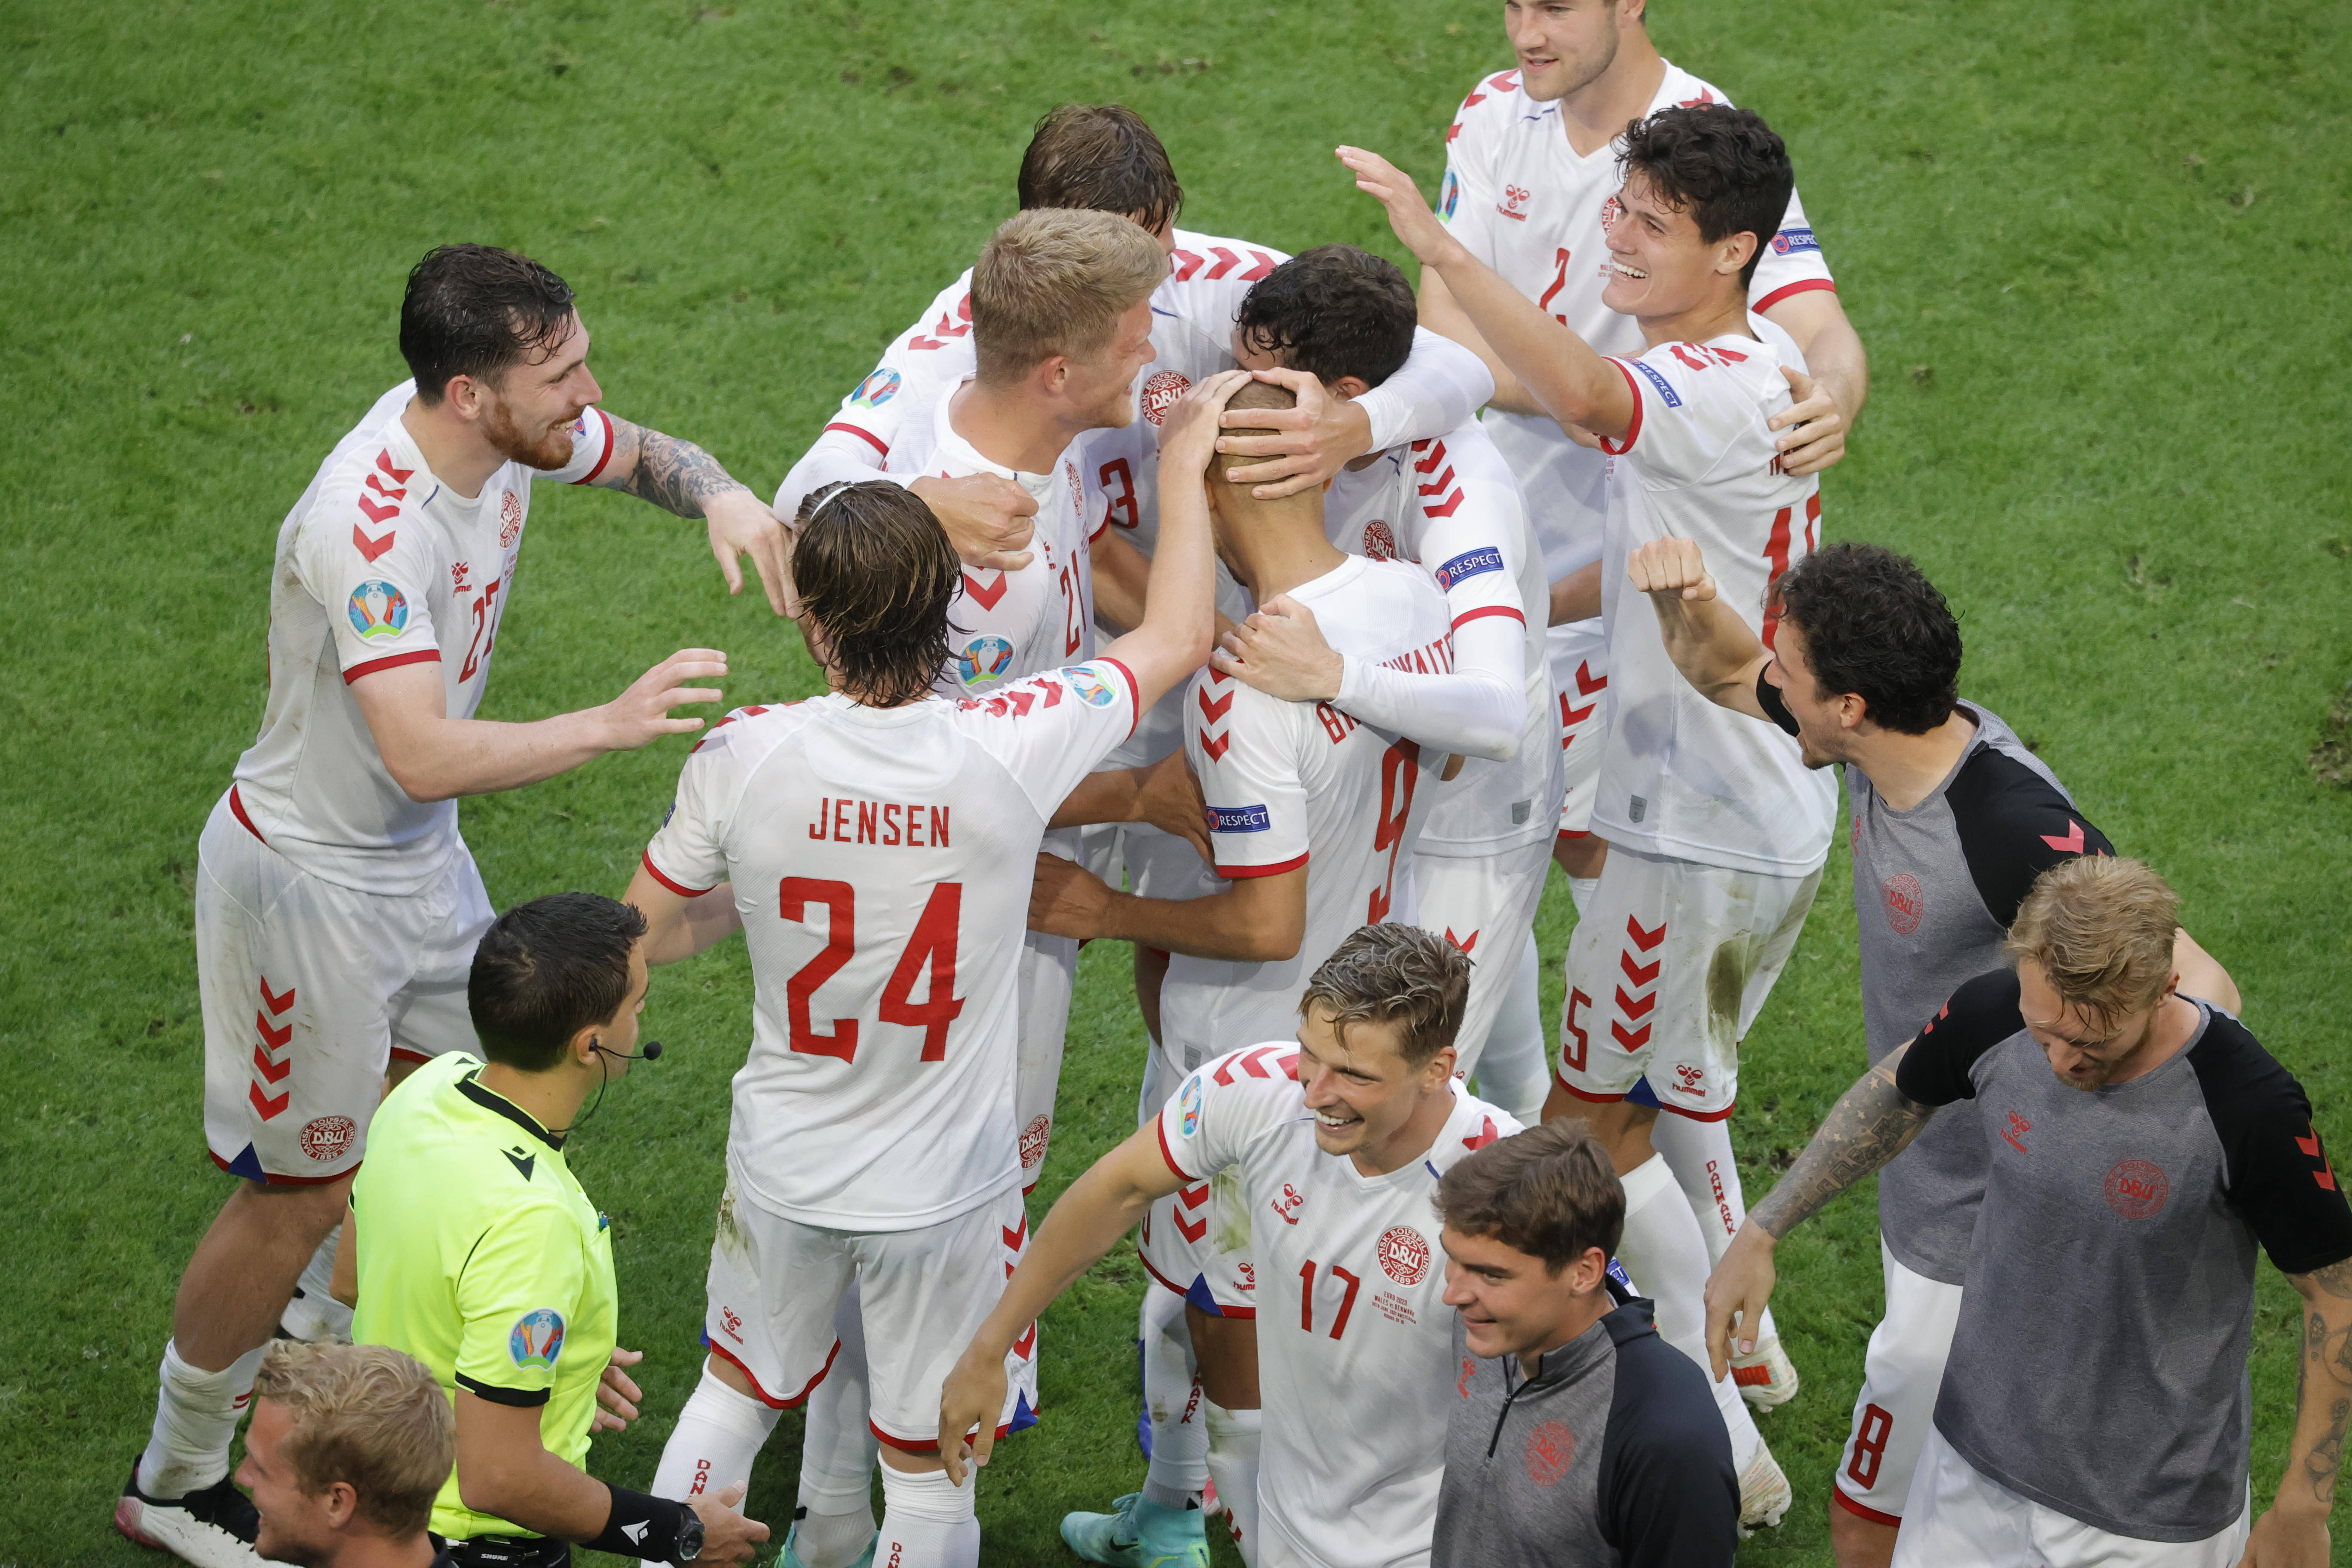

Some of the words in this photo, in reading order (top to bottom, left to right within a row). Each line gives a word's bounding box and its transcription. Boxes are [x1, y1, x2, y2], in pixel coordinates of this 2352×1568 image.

[1638, 364, 1678, 406] RESPECT
[1449, 553, 1500, 578] RESPECT
[1060, 549, 1086, 658] 21
[458, 576, 500, 683] 27
[809, 798, 949, 847] JENSEN
[1219, 812, 1266, 826] RESPECT
[1368, 737, 1420, 925] 9
[1889, 890, 1914, 916] DBU
[780, 877, 966, 1065] 24
[1564, 986, 1592, 1072] 5
[1672, 1083, 1706, 1097] hummel
[302, 1127, 314, 1155] DANSK
[340, 1126, 354, 1152] UNION
[311, 1130, 346, 1145] DBU
[1021, 1129, 1043, 1153] DBU
[1706, 1160, 1736, 1236] DANMARK
[2118, 1178, 2155, 1199] DBU
[1271, 1199, 1299, 1225] hummel
[1378, 1235, 1390, 1270] DANSK
[1388, 1242, 1421, 1269] DBU
[1389, 1271, 1411, 1285] 1889
[1413, 1254, 1429, 1283] UNION
[1299, 1259, 1360, 1340] 17
[1375, 1295, 1389, 1306] WALES
[1395, 1304, 1415, 1317] DENMARK
[1384, 1291, 1395, 1301] EURO
[1396, 1296, 1408, 1306] 2020
[720, 1320, 743, 1345] hummel
[1536, 1436, 1565, 1468] DBU
[1847, 1403, 1893, 1490] 8
